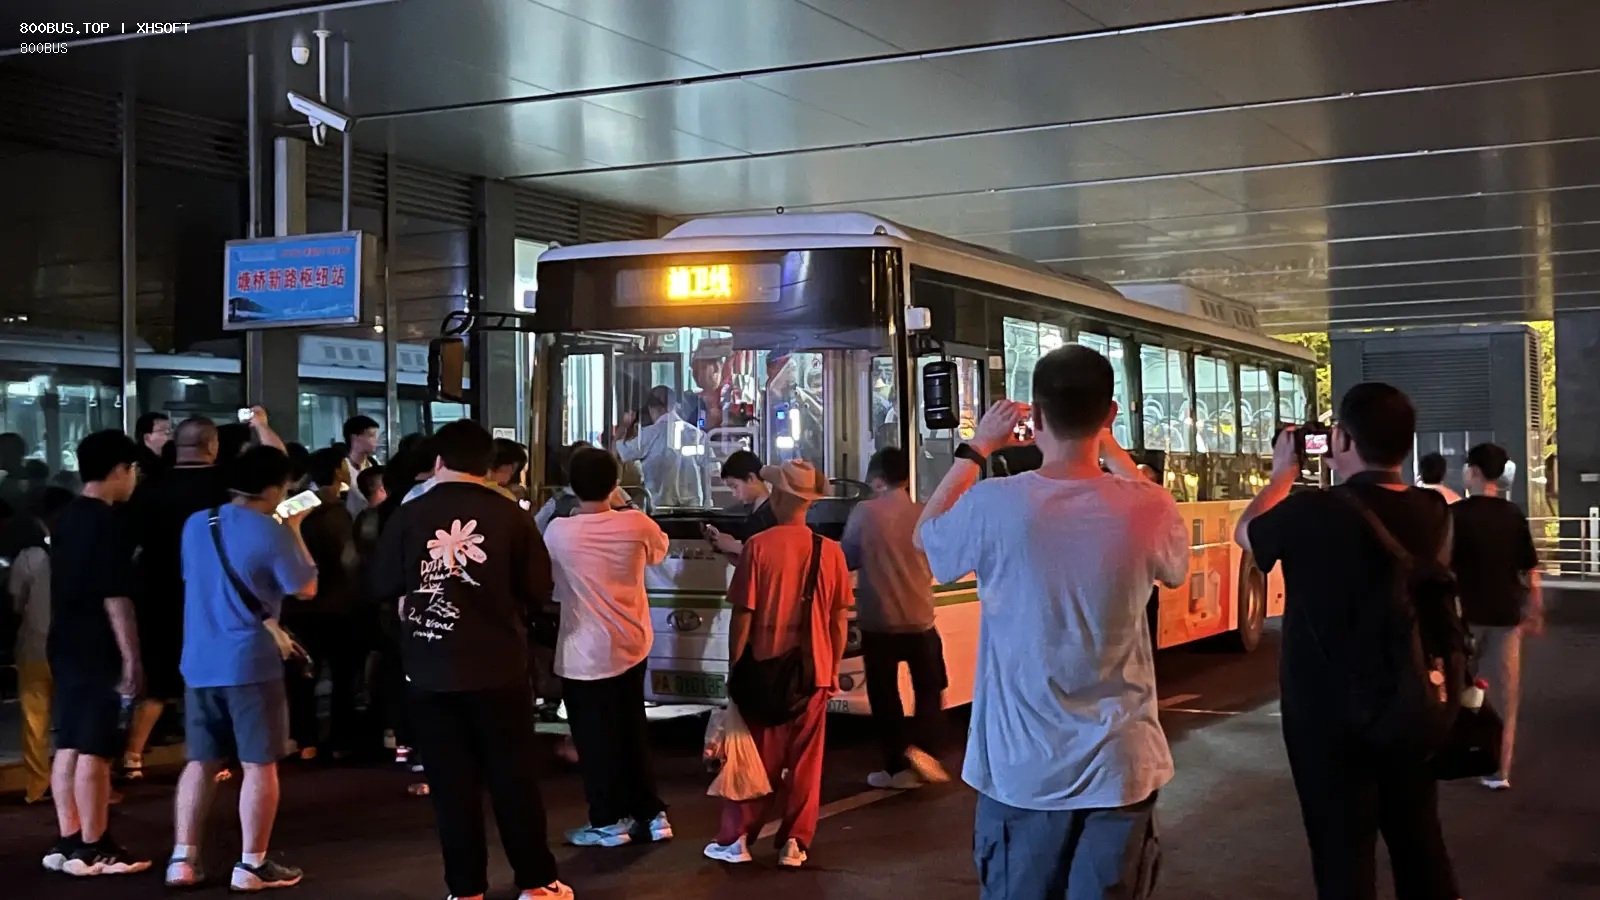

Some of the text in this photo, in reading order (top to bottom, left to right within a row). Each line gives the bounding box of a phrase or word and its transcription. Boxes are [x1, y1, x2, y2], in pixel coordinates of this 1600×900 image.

[236, 264, 347, 293] 塘桥新路枢纽站
